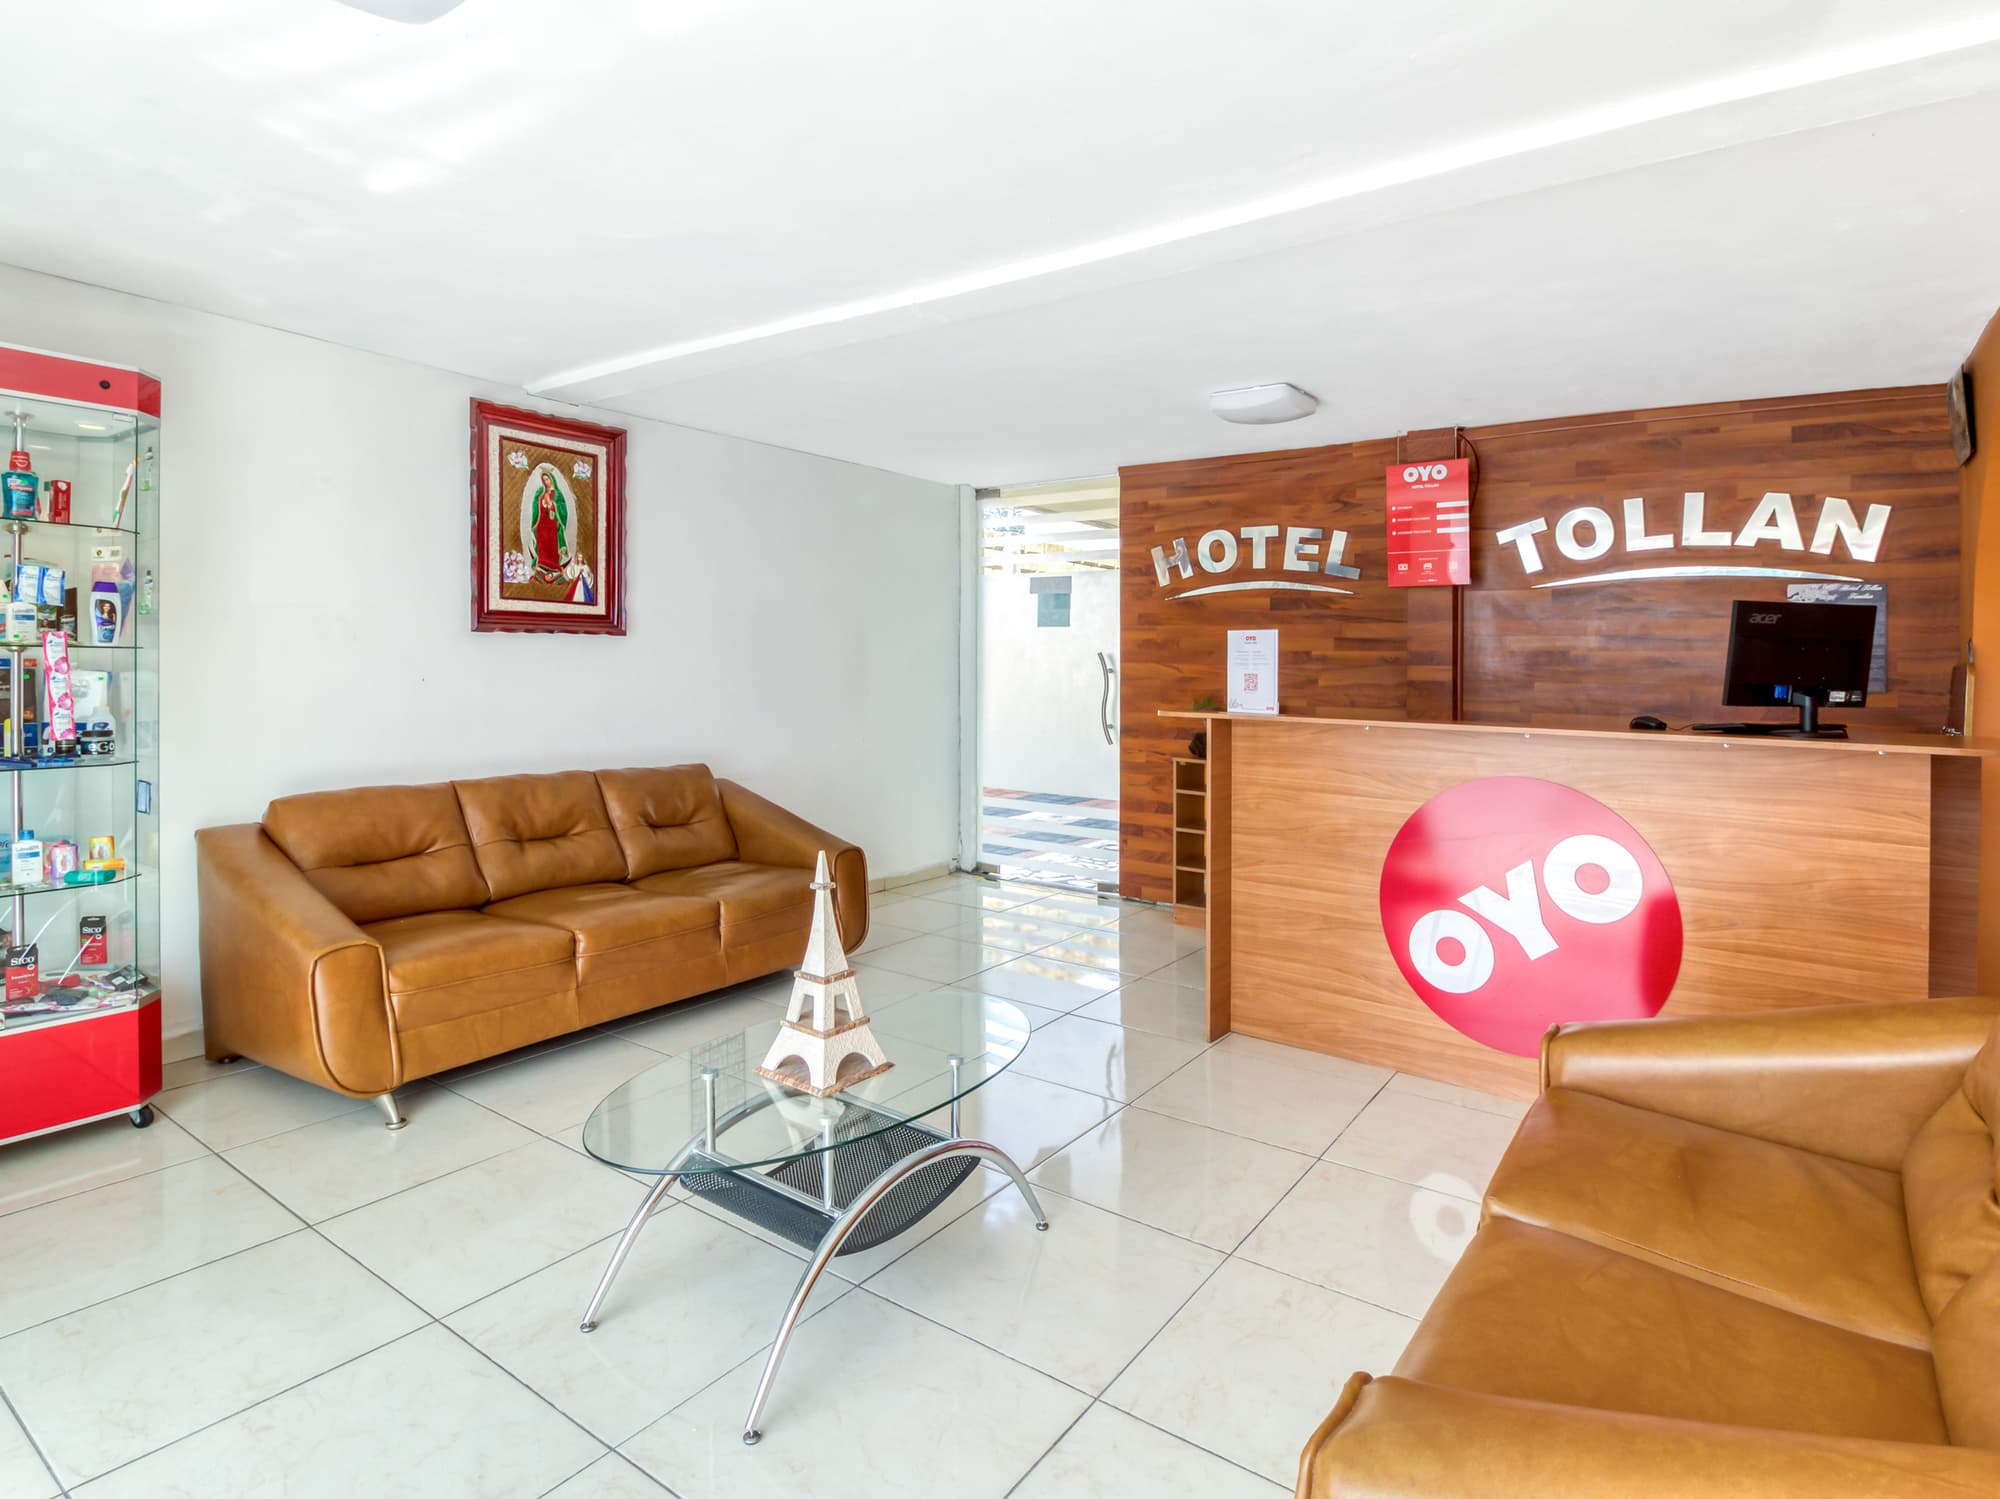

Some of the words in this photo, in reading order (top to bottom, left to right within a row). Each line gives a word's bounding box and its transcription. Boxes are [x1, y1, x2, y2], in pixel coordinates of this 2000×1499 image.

[1403, 464, 1447, 483] OYO
[1151, 525, 1361, 588] HOTEL
[1496, 492, 1892, 575] TOLLAN
[1750, 613, 1783, 625] acer
[1408, 834, 1643, 994] OYO
